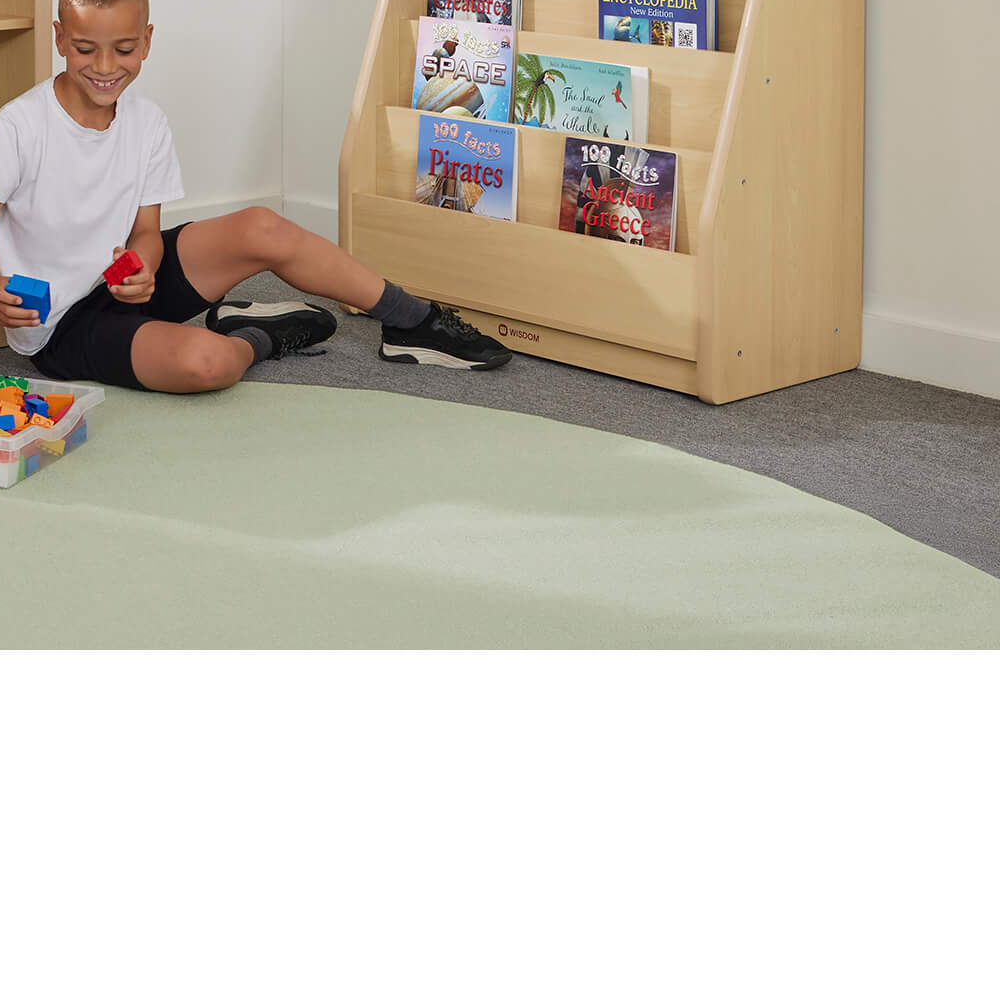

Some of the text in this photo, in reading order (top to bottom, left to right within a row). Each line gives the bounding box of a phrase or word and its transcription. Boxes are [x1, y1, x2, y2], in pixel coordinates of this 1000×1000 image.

[630, 7, 674, 18] New Edition
[432, 23, 500, 55] 100 facts
[422, 54, 507, 87] SPACE
[562, 87, 606, 105] The Snail
[584, 105, 595, 114] the
[433, 122, 501, 156] 100 facts
[562, 113, 600, 134] Whale
[428, 147, 503, 188] Pirates
[581, 144, 659, 182] 100 facts
[581, 176, 656, 211] Ancient
[582, 200, 651, 236] Greece
[509, 328, 540, 343] WISDOM
